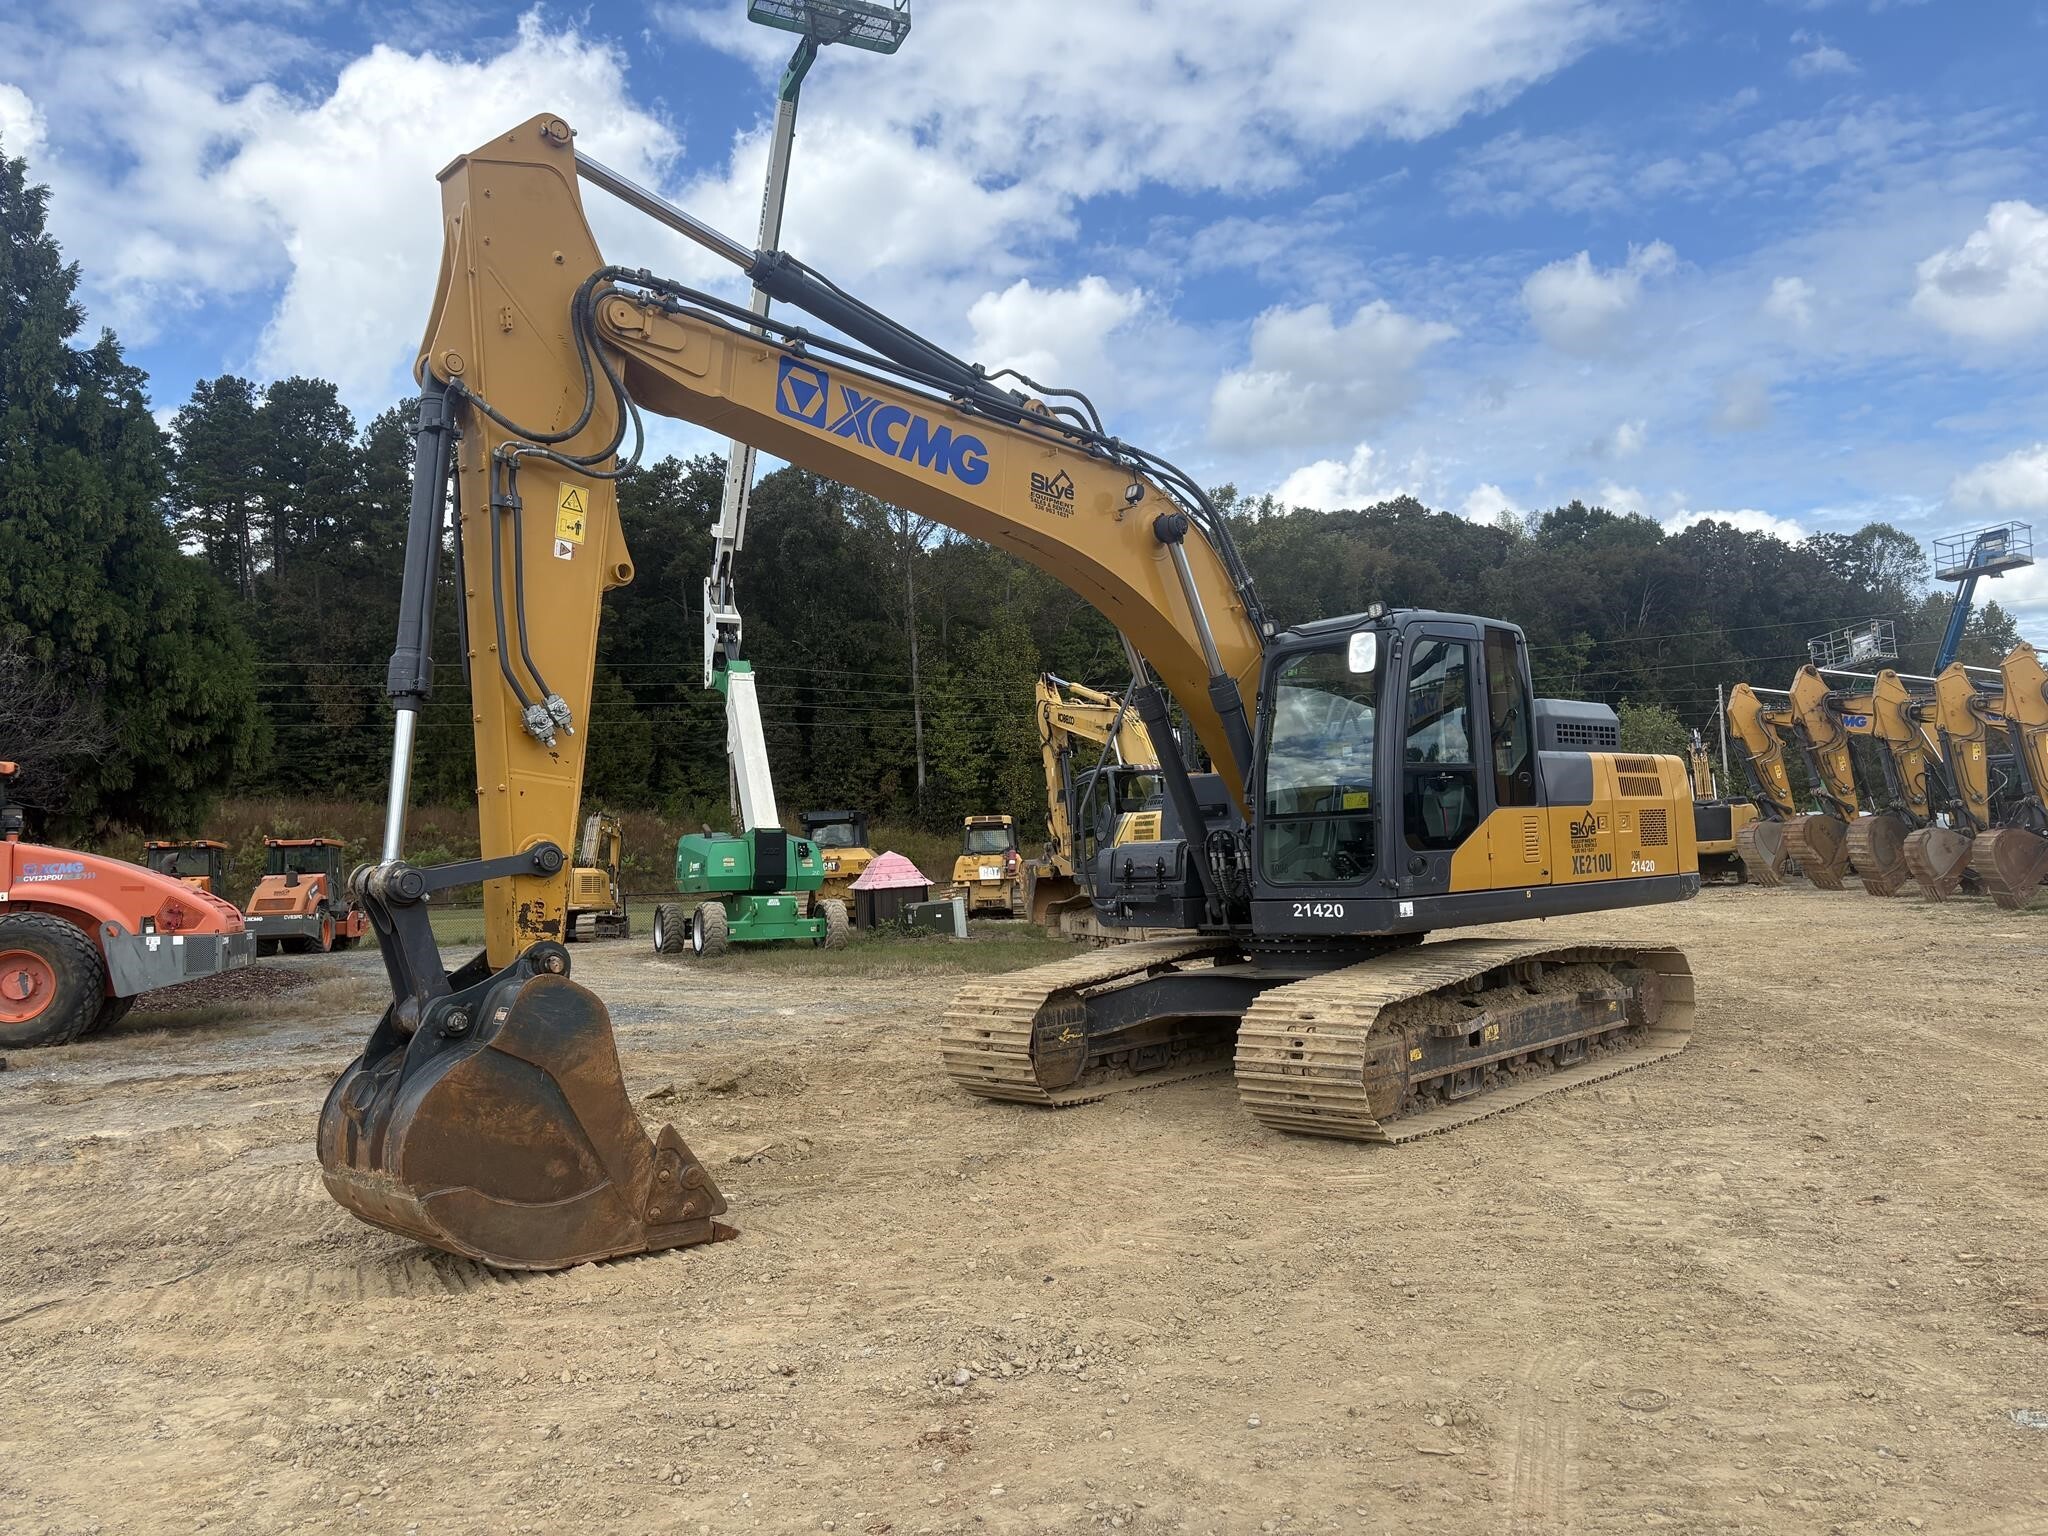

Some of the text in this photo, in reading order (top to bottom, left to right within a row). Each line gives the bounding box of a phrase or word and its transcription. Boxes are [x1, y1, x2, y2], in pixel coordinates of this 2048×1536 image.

[825, 385, 989, 485] XCMG
[1031, 491, 1074, 509] EQUIPMENT
[1842, 715, 1867, 727] MG
[1570, 810, 1597, 838] Skye
[41, 862, 84, 874] XCMG
[822, 861, 837, 871] CAT
[1572, 853, 1612, 875] XE210U
[1631, 860, 1655, 872] 21420
[23, 874, 63, 882] CV123PDU
[1292, 903, 1344, 918] 21420
